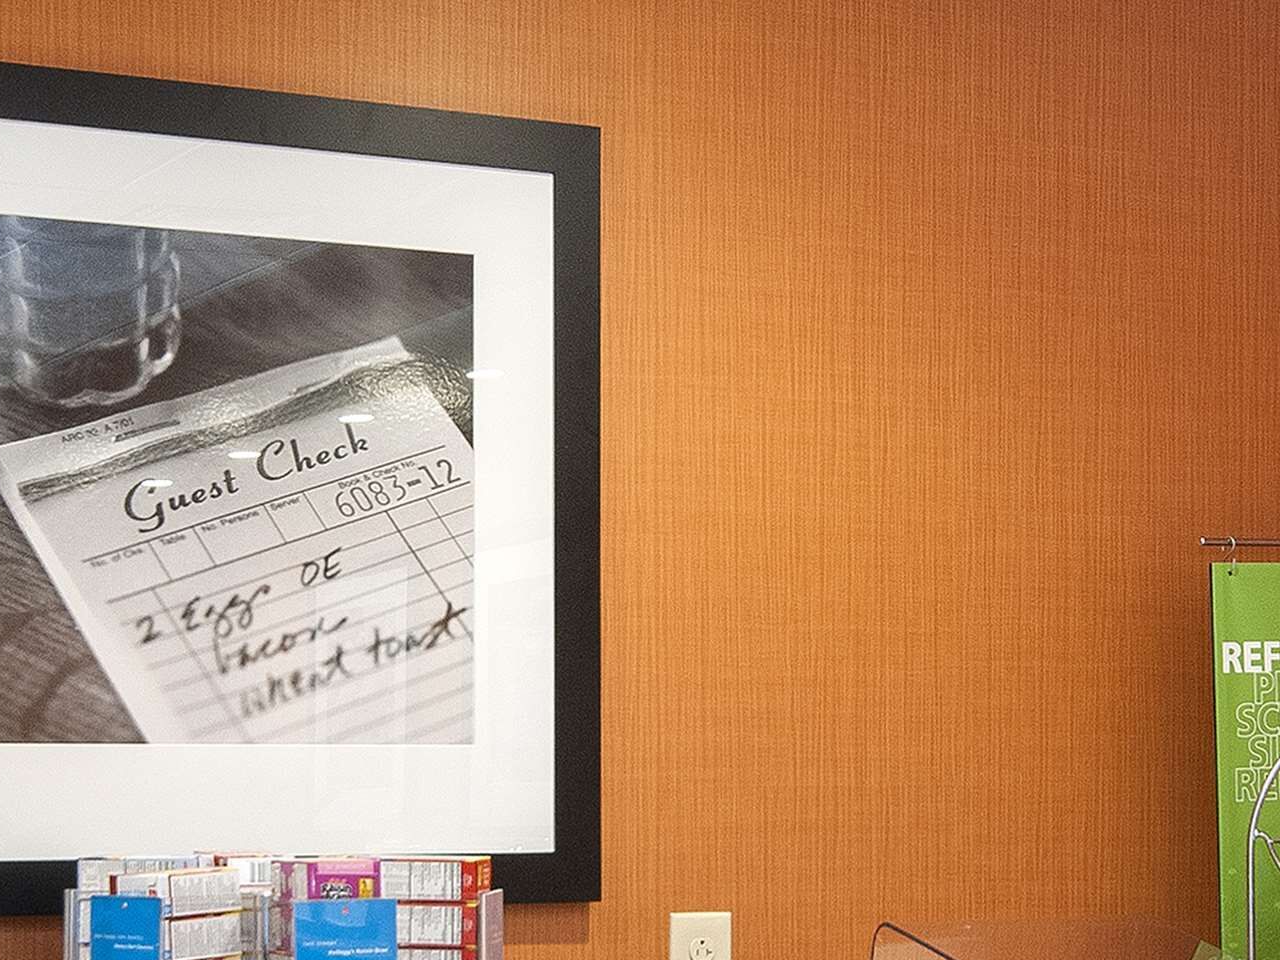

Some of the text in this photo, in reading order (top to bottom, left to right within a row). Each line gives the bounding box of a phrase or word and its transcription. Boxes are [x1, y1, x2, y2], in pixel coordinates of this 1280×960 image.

[124, 422, 369, 533] Guest Check
[335, 459, 461, 517] 6083-12
[338, 478, 362, 490] Book
[371, 463, 400, 478] Check
[270, 497, 300, 511] Server
[220, 510, 261, 527] Persons
[159, 534, 187, 546] Table
[136, 616, 162, 645] 2
[300, 547, 342, 587] OE
